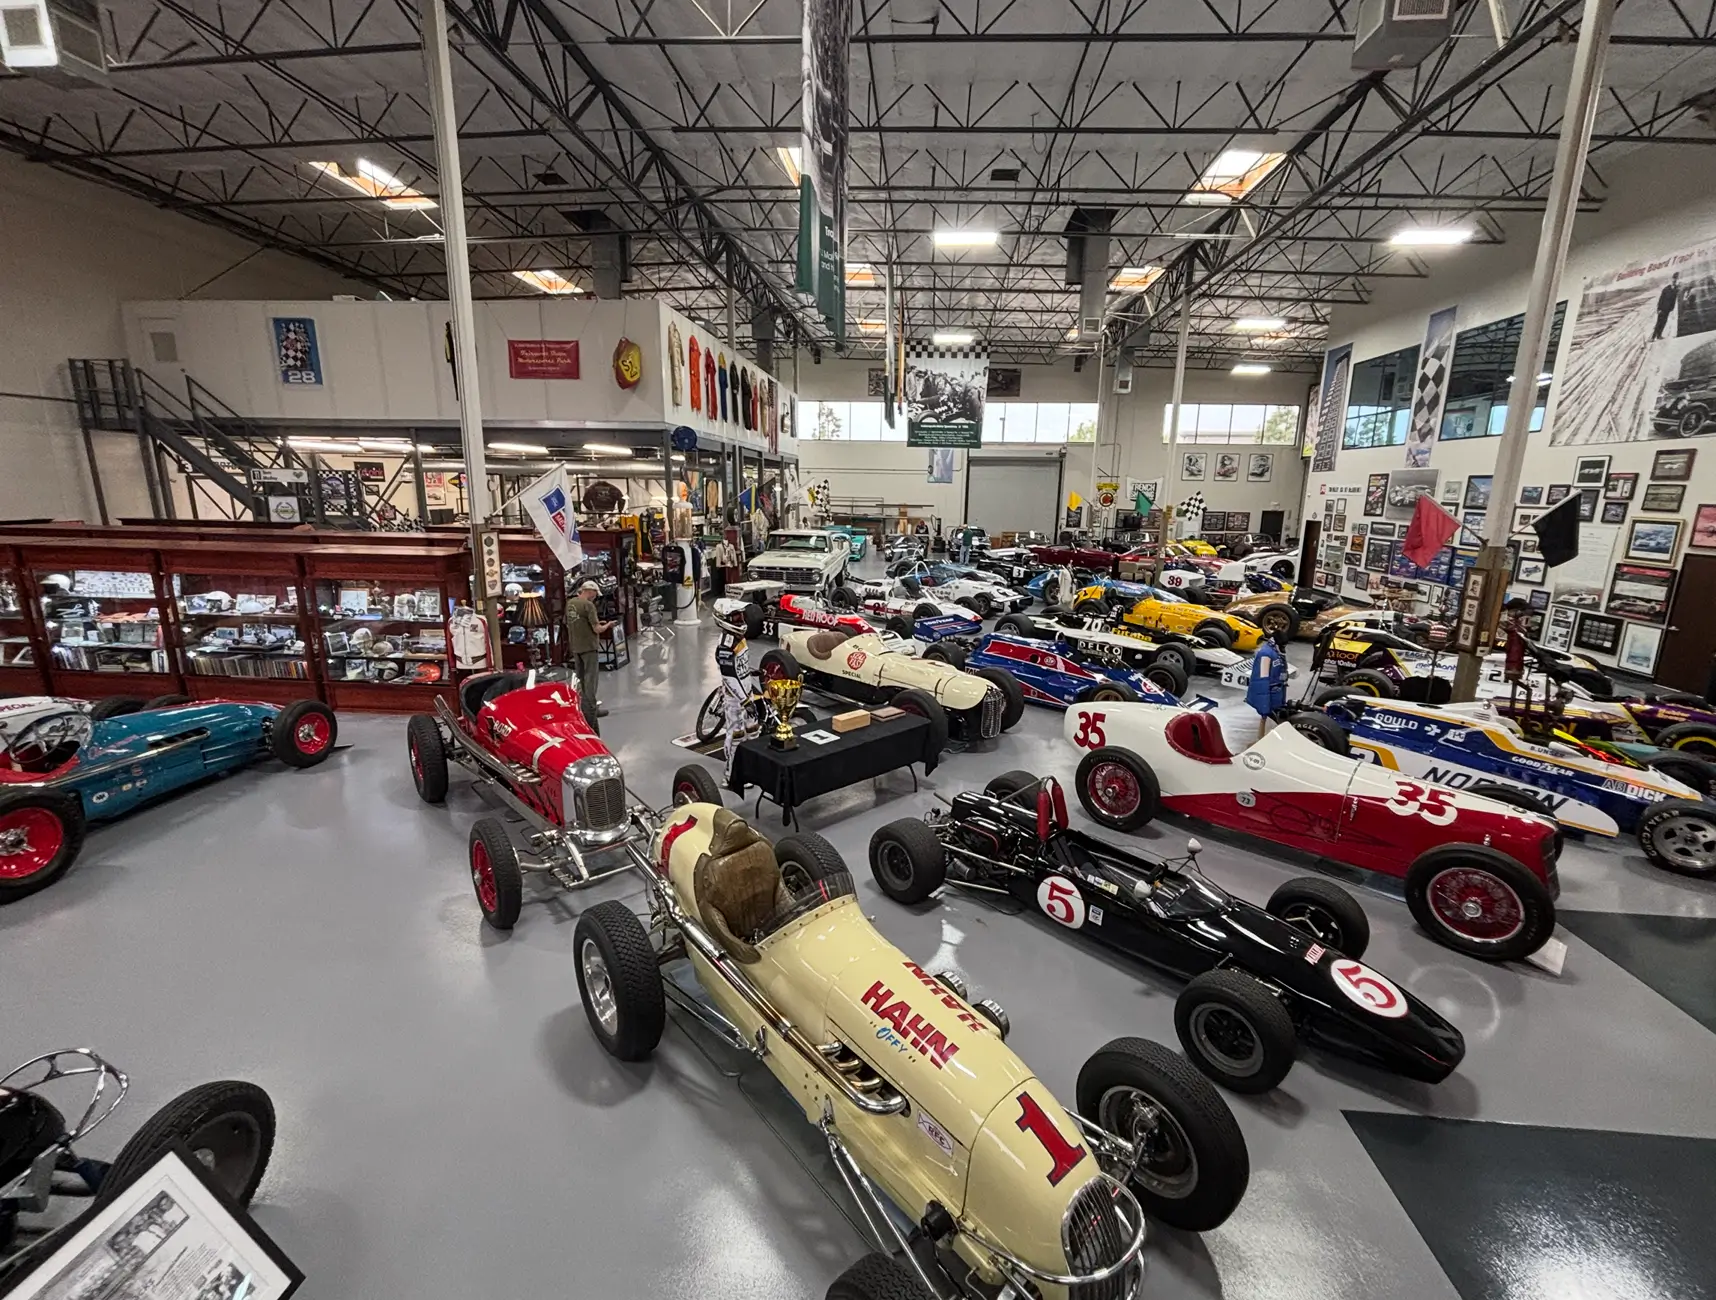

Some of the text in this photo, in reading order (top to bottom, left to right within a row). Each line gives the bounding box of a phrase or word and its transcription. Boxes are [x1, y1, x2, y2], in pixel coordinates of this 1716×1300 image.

[288, 370, 316, 384] 28
[1131, 482, 1156, 492] TRENCH
[1167, 575, 1182, 587] 39
[872, 602, 881, 616] 2
[802, 610, 839, 627] RED ROOF
[1082, 617, 1103, 632] 70
[762, 621, 774, 636] 33
[1111, 627, 1153, 643] Futaba
[1079, 640, 1121, 656] DELCO
[842, 669, 862, 679] SPECIAL
[1224, 672, 1233, 683] 3
[1375, 713, 1419, 730] GOULD
[812, 733, 829, 741] 1
[1074, 711, 1107, 751] 35
[1511, 755, 1575, 777] GOODYEAR
[1627, 784, 1667, 802] DICK
[1383, 780, 1458, 826] 35
[1046, 880, 1076, 924] 5
[1336, 961, 1397, 1010] 5
[860, 980, 960, 1070] HAHN
[1015, 1090, 1087, 1188] 1
